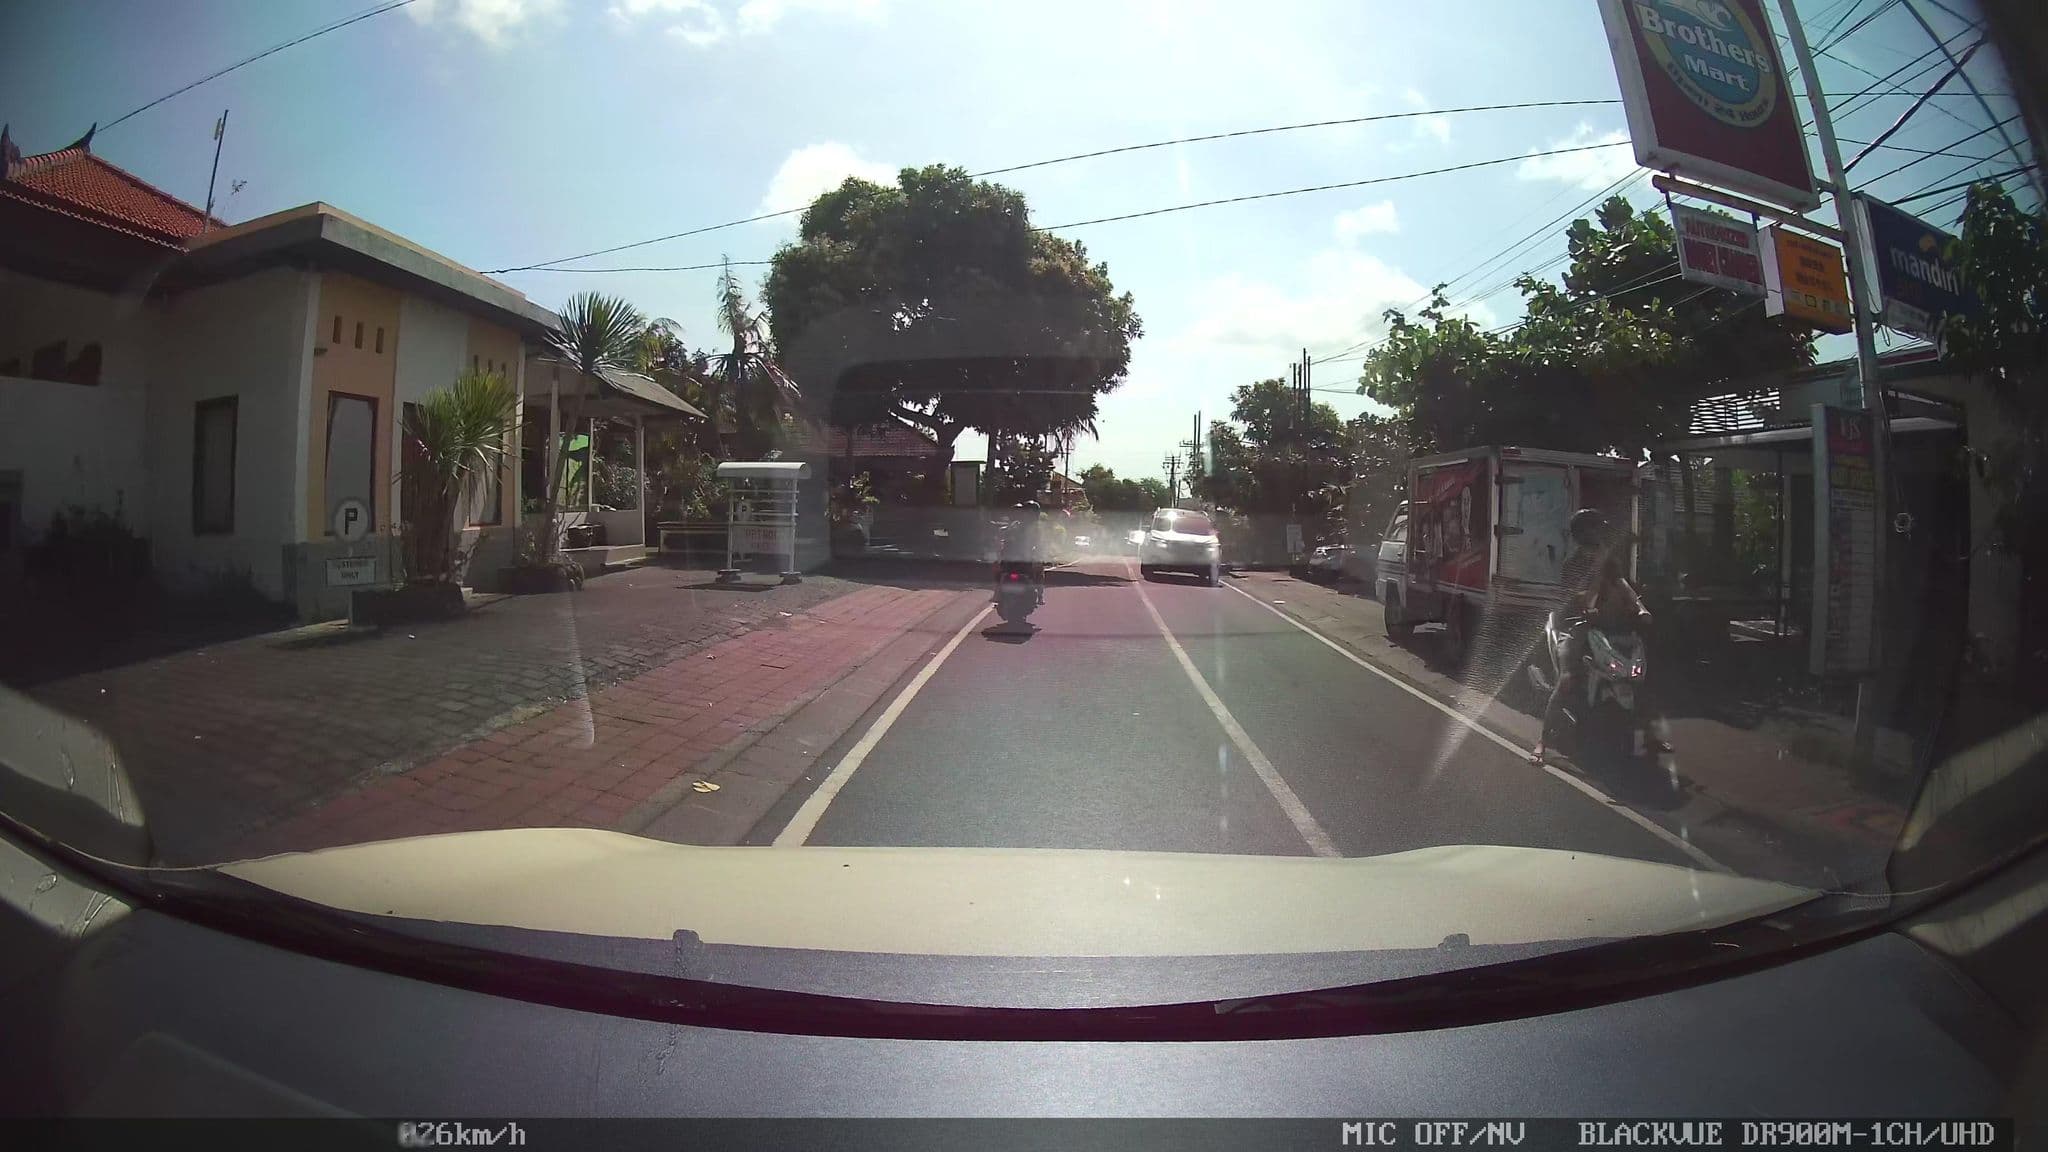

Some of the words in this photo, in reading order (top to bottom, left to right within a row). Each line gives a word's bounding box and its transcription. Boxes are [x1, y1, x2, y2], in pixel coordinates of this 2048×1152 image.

[1634, 3, 1770, 73] Brothers
[1683, 54, 1750, 92] Mart
[344, 508, 358, 535] P
